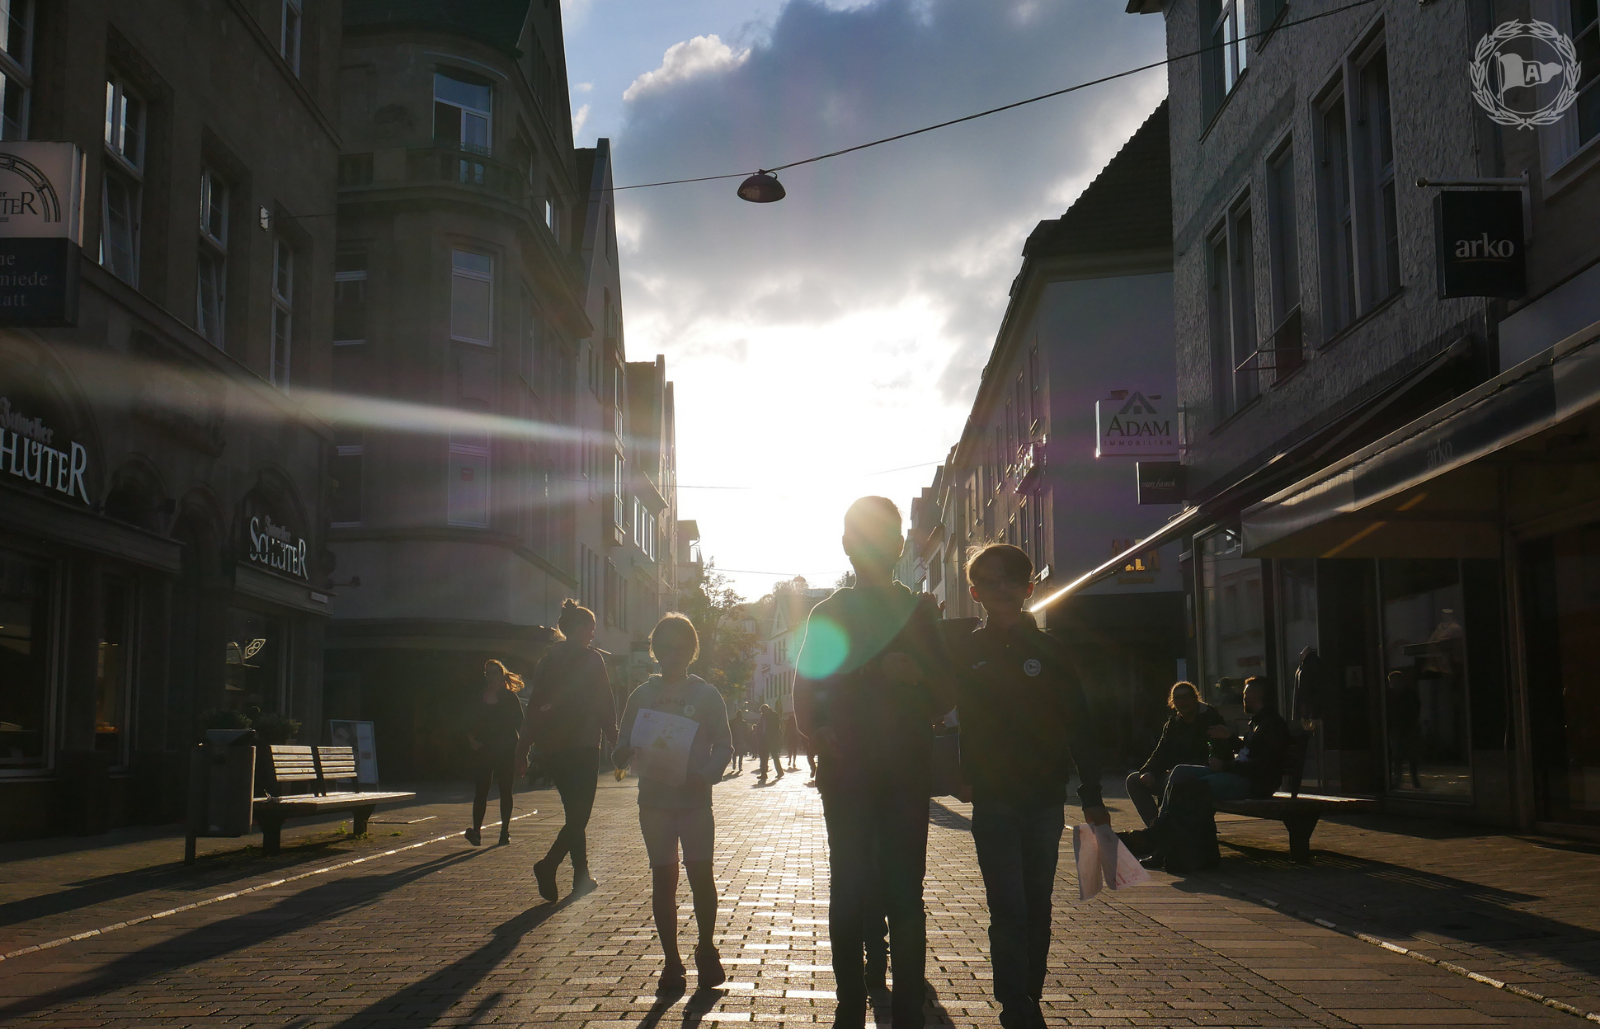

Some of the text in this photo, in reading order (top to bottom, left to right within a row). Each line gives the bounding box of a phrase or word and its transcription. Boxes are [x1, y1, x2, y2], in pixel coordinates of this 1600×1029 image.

[1455, 232, 1515, 258] arko
[1427, 438, 1453, 470] arko
[651, 696, 686, 709] CANAD
